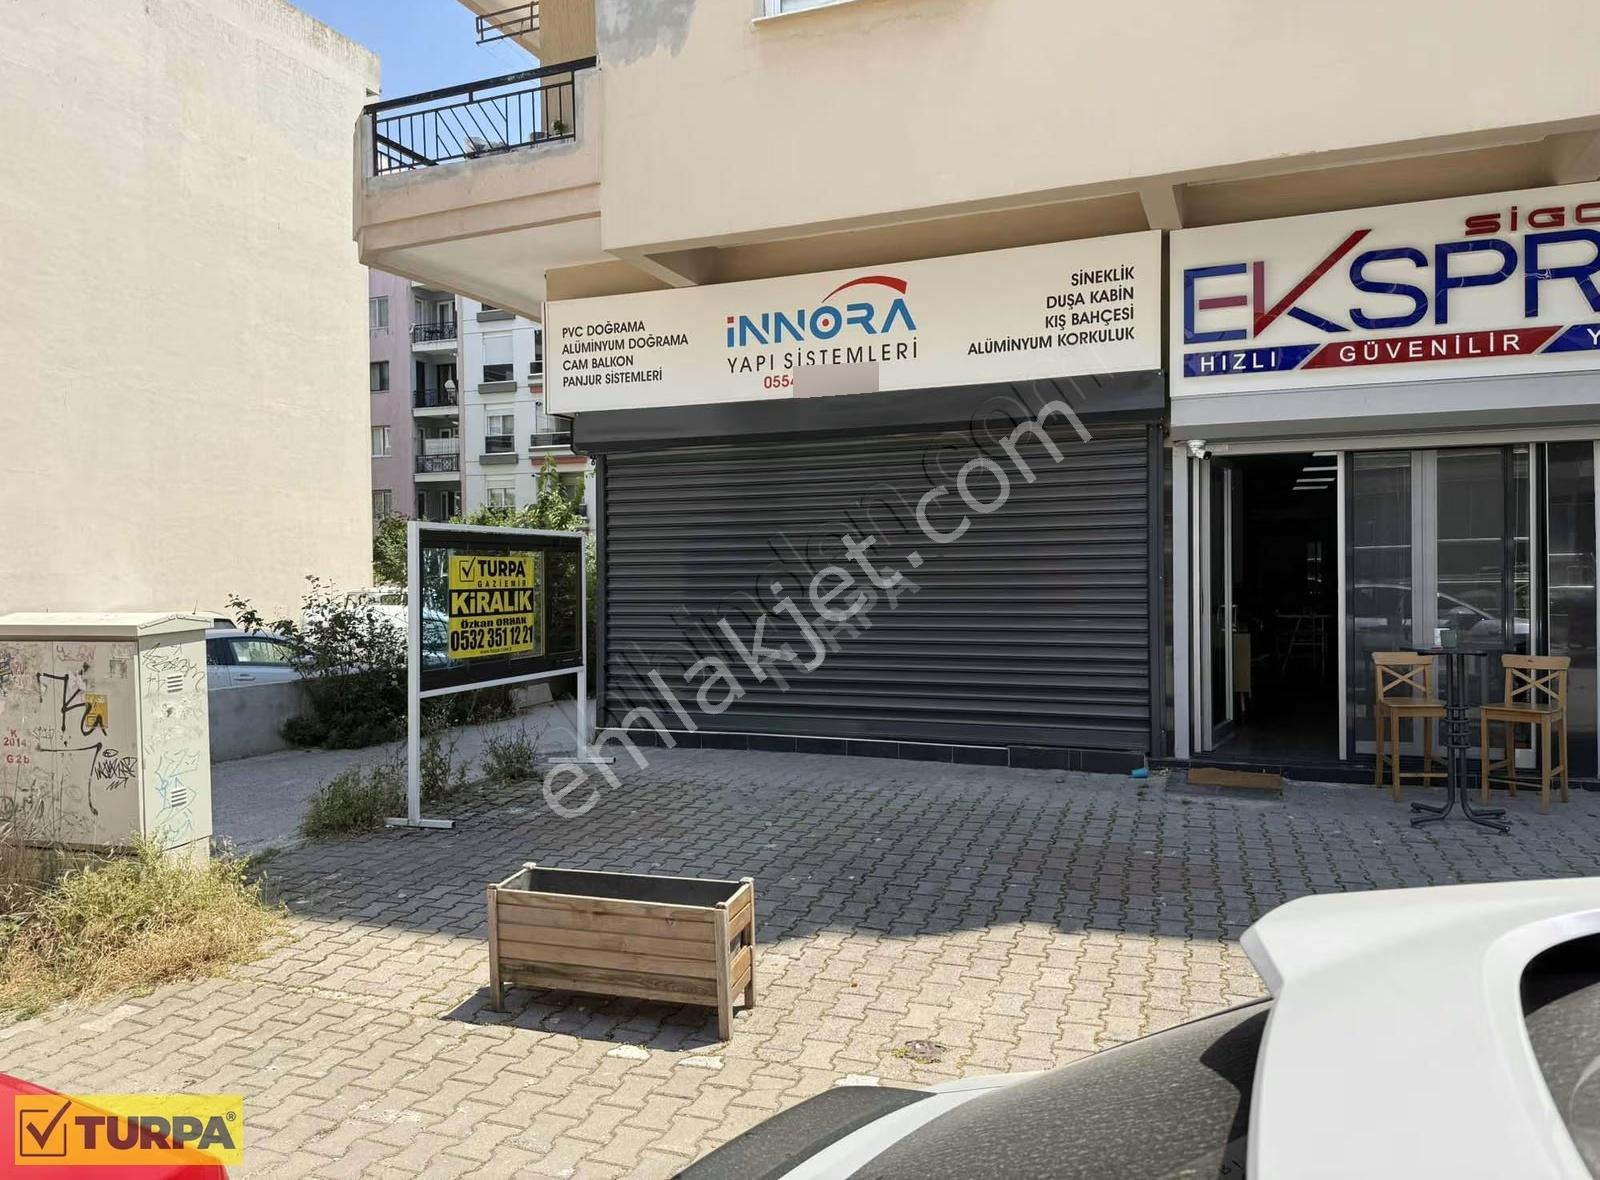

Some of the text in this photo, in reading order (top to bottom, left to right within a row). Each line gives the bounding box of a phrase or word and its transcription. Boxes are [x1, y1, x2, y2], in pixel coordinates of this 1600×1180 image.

[1071, 264, 1135, 286] SİNEKLİK
[1046, 285, 1134, 310] DUŞA KABİN
[1045, 304, 1134, 330] KIŞ BAHÇESİ
[562, 320, 646, 338] PVC DOĞRAMA
[562, 334, 689, 355] ALÜMİNYUM DOĞRAMA
[968, 327, 1135, 355] ALÜMİNYUM KORKULUK
[562, 355, 634, 371] CAM BALKON
[727, 336, 917, 374] YAPI SİSTEMLERİ
[1200, 352, 1276, 373] HIZLI
[1340, 333, 1521, 363] GÜVENİLİR
[563, 366, 663, 387] PANJUR SİSTEMLERİ
[477, 560, 526, 577] TURPA
[450, 625, 533, 651] 0532 351 12 21
